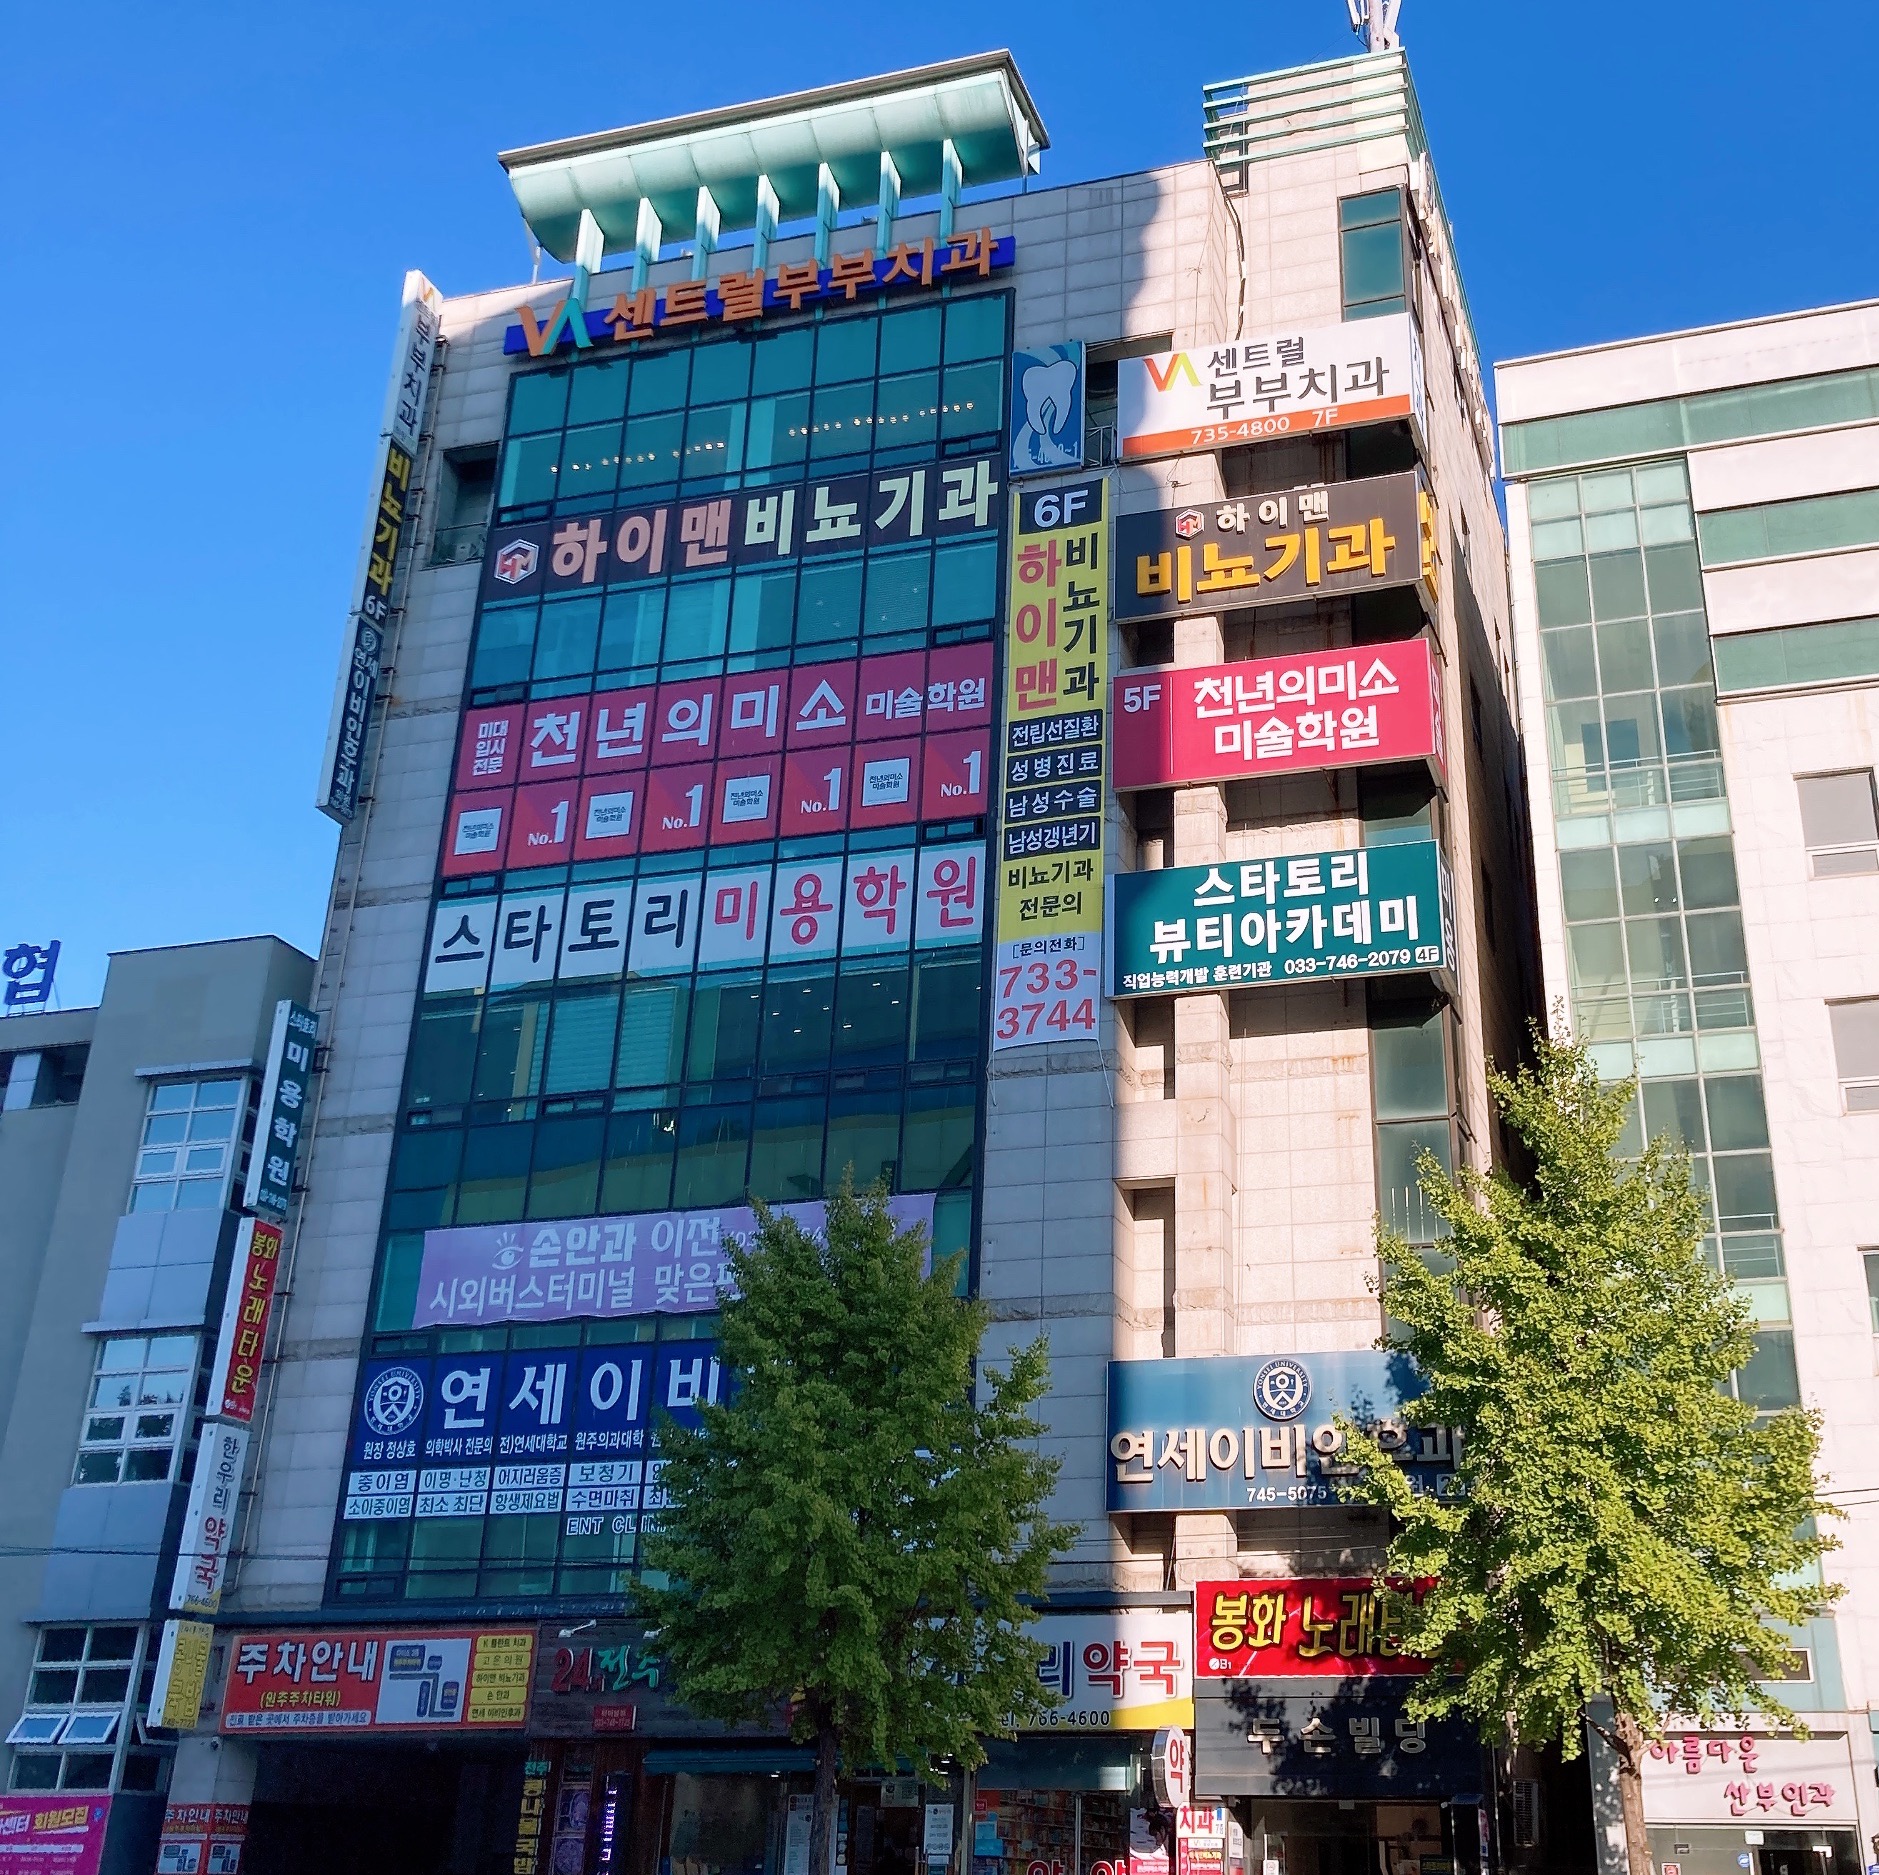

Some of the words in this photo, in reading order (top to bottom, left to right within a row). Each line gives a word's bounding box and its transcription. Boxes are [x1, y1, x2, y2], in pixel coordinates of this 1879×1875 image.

[604, 226, 1000, 341] 센트럴부부치과
[1207, 336, 1305, 379] 센트럴
[1206, 356, 1389, 420] 부부치과
[1191, 416, 1290, 445] 735-4800
[1312, 408, 1338, 428] 7F
[369, 448, 411, 597] 비뇨기과
[1034, 489, 1088, 528] 6F
[1216, 490, 1329, 533] 하이맨
[1136, 518, 1395, 603] 비뇨기과
[364, 595, 387, 621] 6F
[1015, 539, 1062, 712] 하이맨
[1062, 532, 1100, 701] 비뇨기과
[1123, 684, 1162, 713] 5F
[1193, 657, 1399, 719] 천년의미소
[478, 720, 509, 739] 미대
[530, 679, 847, 768] 천년의미소
[865, 677, 986, 721] 미술학원
[1012, 714, 1098, 747] 전립선질환
[1214, 705, 1379, 760] 미술학원
[472, 756, 504, 777] 전문
[477, 738, 506, 758] 입시
[1010, 752, 1098, 783] 성병진료
[801, 767, 842, 814] No.1
[941, 749, 982, 798] No.1
[662, 784, 703, 830] No.1
[1009, 785, 1097, 817] 남성수술
[528, 800, 569, 846] No.1
[1008, 822, 1096, 854] 남성갱년기
[1008, 858, 1094, 889] 비뇨기과
[1193, 851, 1369, 907] 스타토리
[1019, 892, 1082, 921] 전문의
[1150, 895, 1419, 964] 뷰티아카데미
[2, 939, 61, 1005] 협
[999, 958, 1097, 999] 733-
[1123, 967, 1209, 990] 직업능력개발
[1213, 960, 1272, 982] 훈련기관
[1284, 950, 1411, 975] 033-746-2079
[1417, 947, 1438, 962] 4F
[996, 998, 1096, 1041] 3744
[268, 1041, 310, 1187] 미용학원
[251, 1231, 279, 1261] 봉화
[529, 1222, 637, 1269] 손안과
[651, 1217, 723, 1258] 이전
[429, 1266, 635, 1319] 시외버스터미널
[231, 1262, 267, 1394] 노래타운
[1256, 1365, 1274, 1390] YONSEI
[1275, 1361, 1308, 1387] UNIVERSITY
[364, 1441, 383, 1460] 원장
[385, 1440, 417, 1459] 정상호
[425, 1437, 463, 1457] 의학박사
[465, 1436, 493, 1456] 전문의
[500, 1434, 568, 1455] 전)연세대학교
[575, 1429, 645, 1451] 원주의과대학
[358, 1473, 409, 1492] 중이염
[499, 1466, 562, 1486] 어지러움증
[579, 1464, 634, 1483] 보청기
[1246, 1485, 1327, 1503] 745-5075
[348, 1497, 411, 1516] 소아중이염
[419, 1496, 449, 1514] 최소
[453, 1495, 484, 1513] 최단
[495, 1491, 560, 1511] 항생제요법
[571, 1489, 634, 1509] 수면마취
[566, 1517, 604, 1537] ENT
[195, 1516, 227, 1594] 약국
[1209, 1593, 1287, 1650] 봉화
[236, 1641, 378, 1684] 주차안내
[512, 1638, 526, 1648] 치과
[476, 1673, 496, 1683] 하이맨
[498, 1673, 525, 1683] 비뇨기과
[328, 1713, 367, 1724] 받아가세요
[1029, 1710, 1110, 1727] 766-4600
[1247, 1717, 1427, 1755] 두손빌딩
[1169, 1739, 1185, 1794] 약
[1650, 1735, 1760, 1775] 아름다운
[165, 1808, 210, 1823] 주차안내
[215, 1808, 249, 1824] 주차안내
[1724, 1780, 1836, 1817] 산부인과
[1180, 1805, 1215, 1834] 치과
